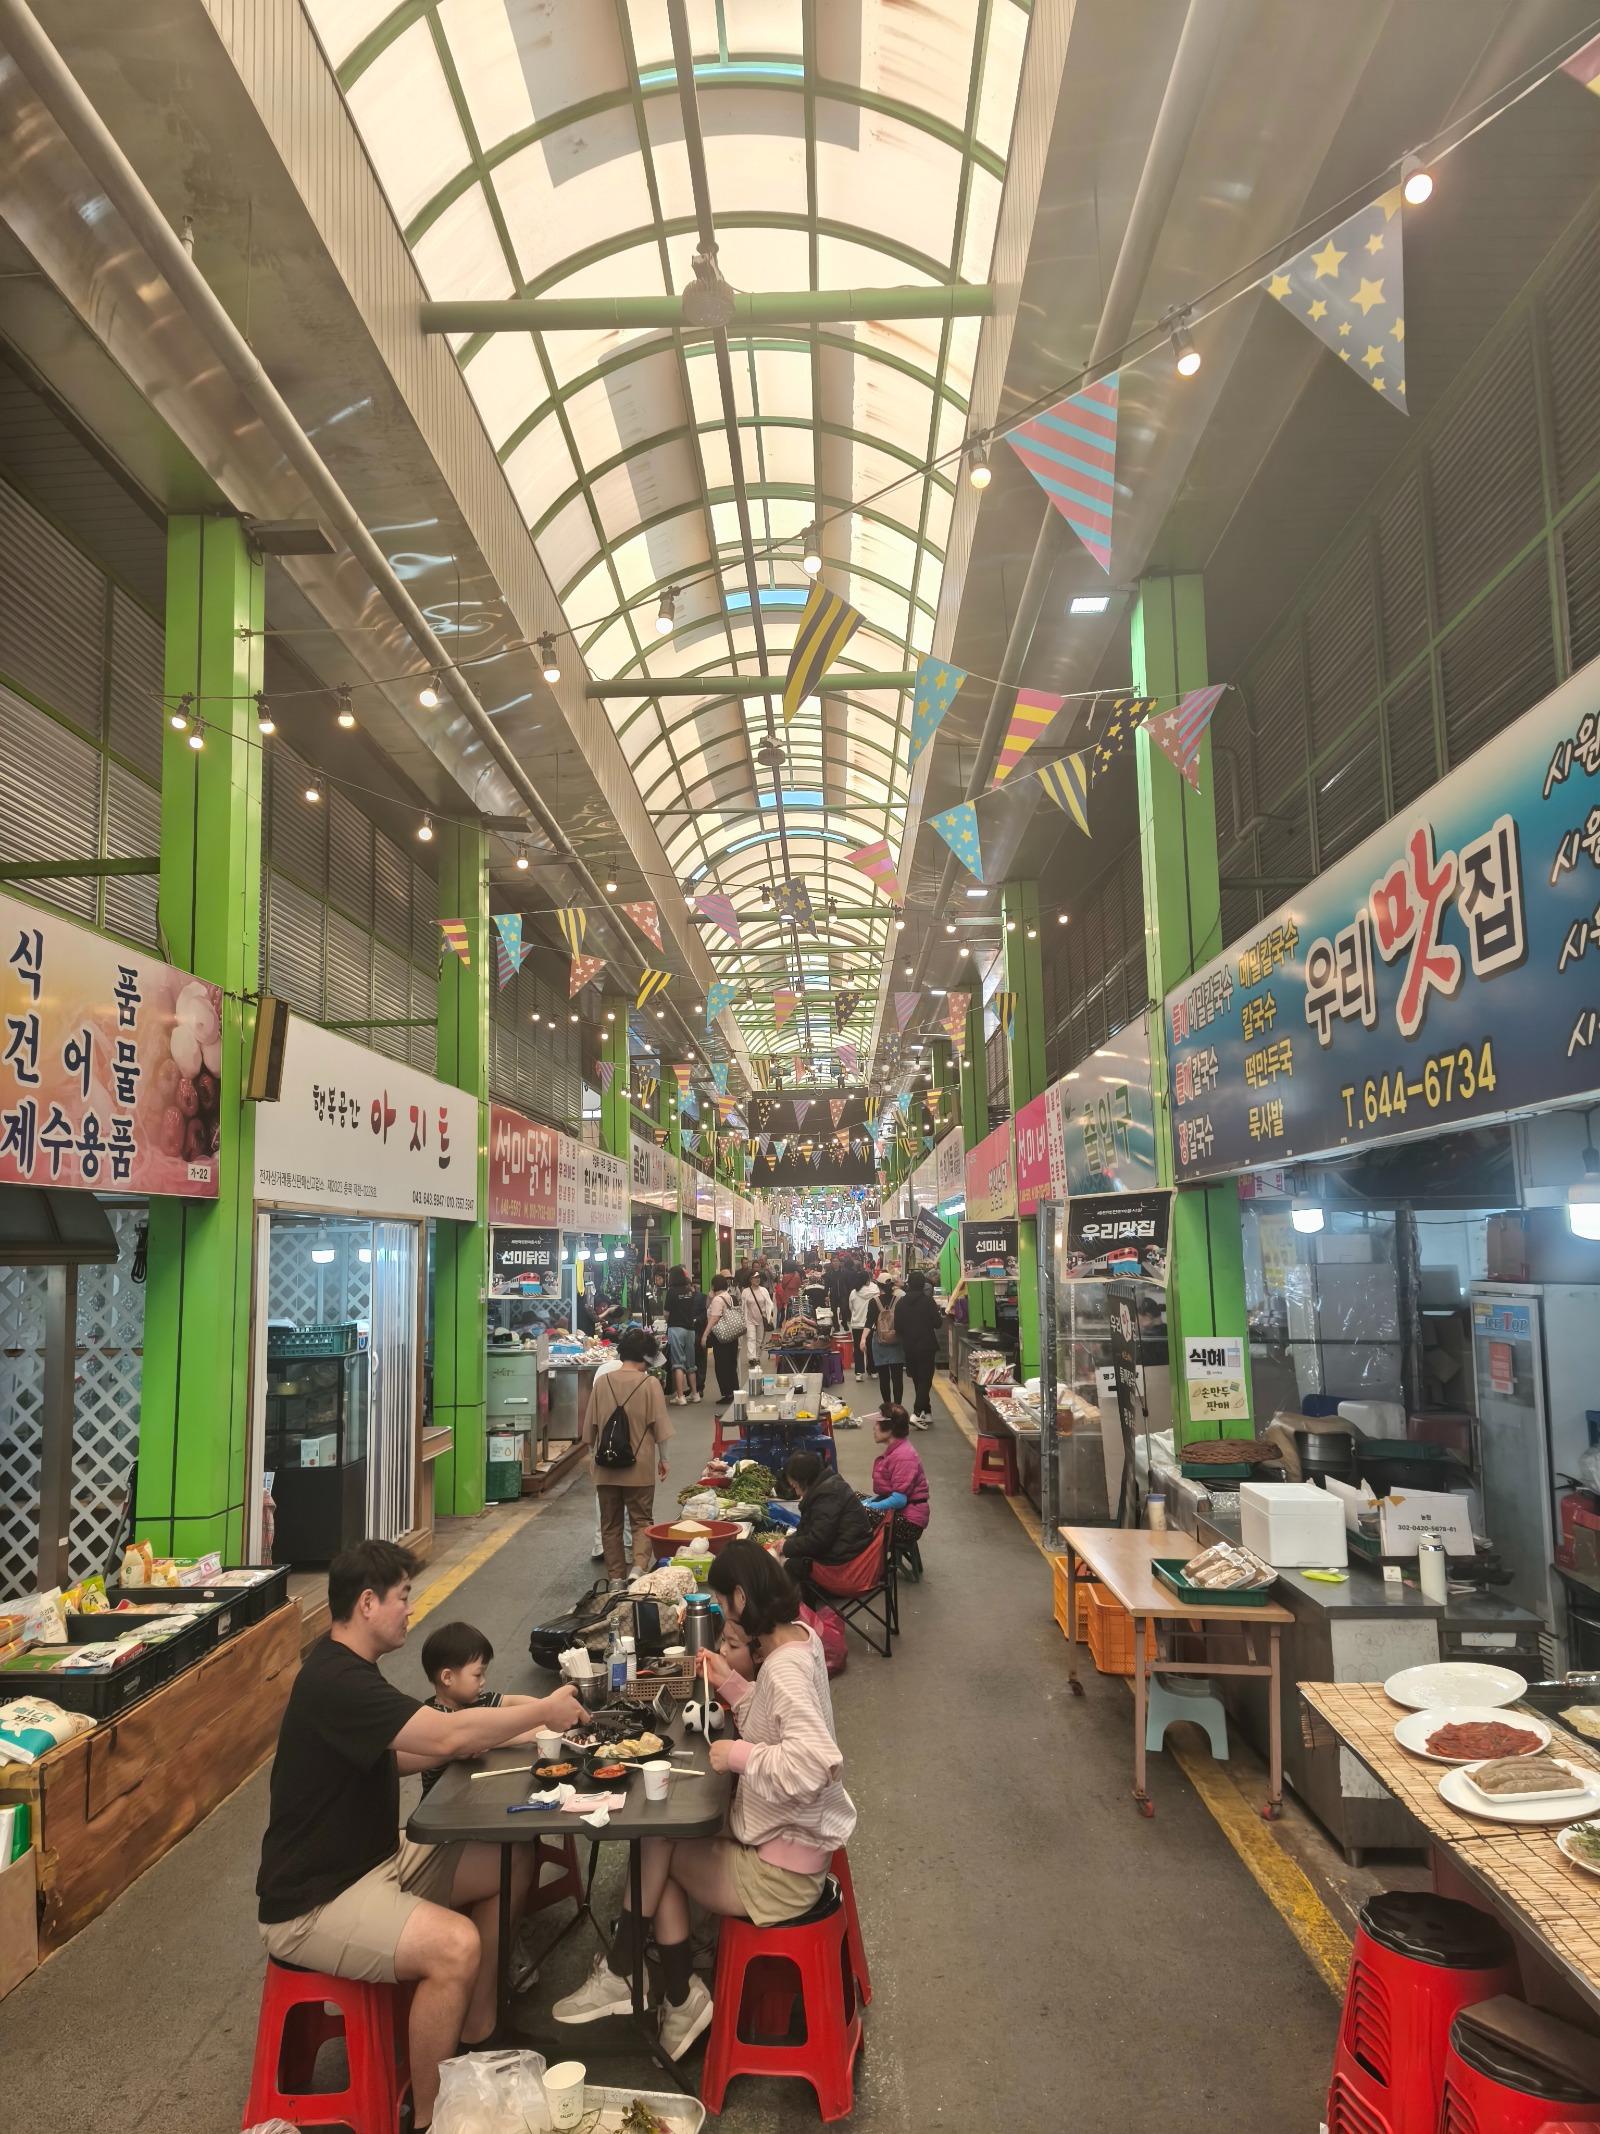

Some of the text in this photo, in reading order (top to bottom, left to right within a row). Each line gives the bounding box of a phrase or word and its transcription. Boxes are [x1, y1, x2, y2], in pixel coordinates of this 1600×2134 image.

[1239, 918, 1299, 989] 메밀칼국수
[1305, 816, 1523, 1044] 우리맛집
[1559, 906, 1600, 971] 시
[1242, 988, 1277, 1041] 칼국수
[4, 1014, 141, 1104] 건어물
[1176, 1045, 1219, 1106] 들깨칼국수
[1245, 1038, 1292, 1090] 떡만두국
[312, 1084, 361, 1129] 행복공간
[1342, 1042, 1497, 1130] T.644-6734
[1, 1100, 136, 1180] 제수용품
[1083, 1085, 1131, 1173] 출입구
[1249, 1098, 1284, 1141] 묵사발
[495, 1120, 553, 1196] 선미닭집
[975, 1239, 1007, 1253] 선미네
[1081, 1219, 1157, 1241] 우리맛집
[501, 1250, 551, 1265] 선미닭집
[1190, 1348, 1226, 1367] 식혜
[1201, 1386, 1231, 1399] 손만두
[1206, 1400, 1230, 1412] 판매
